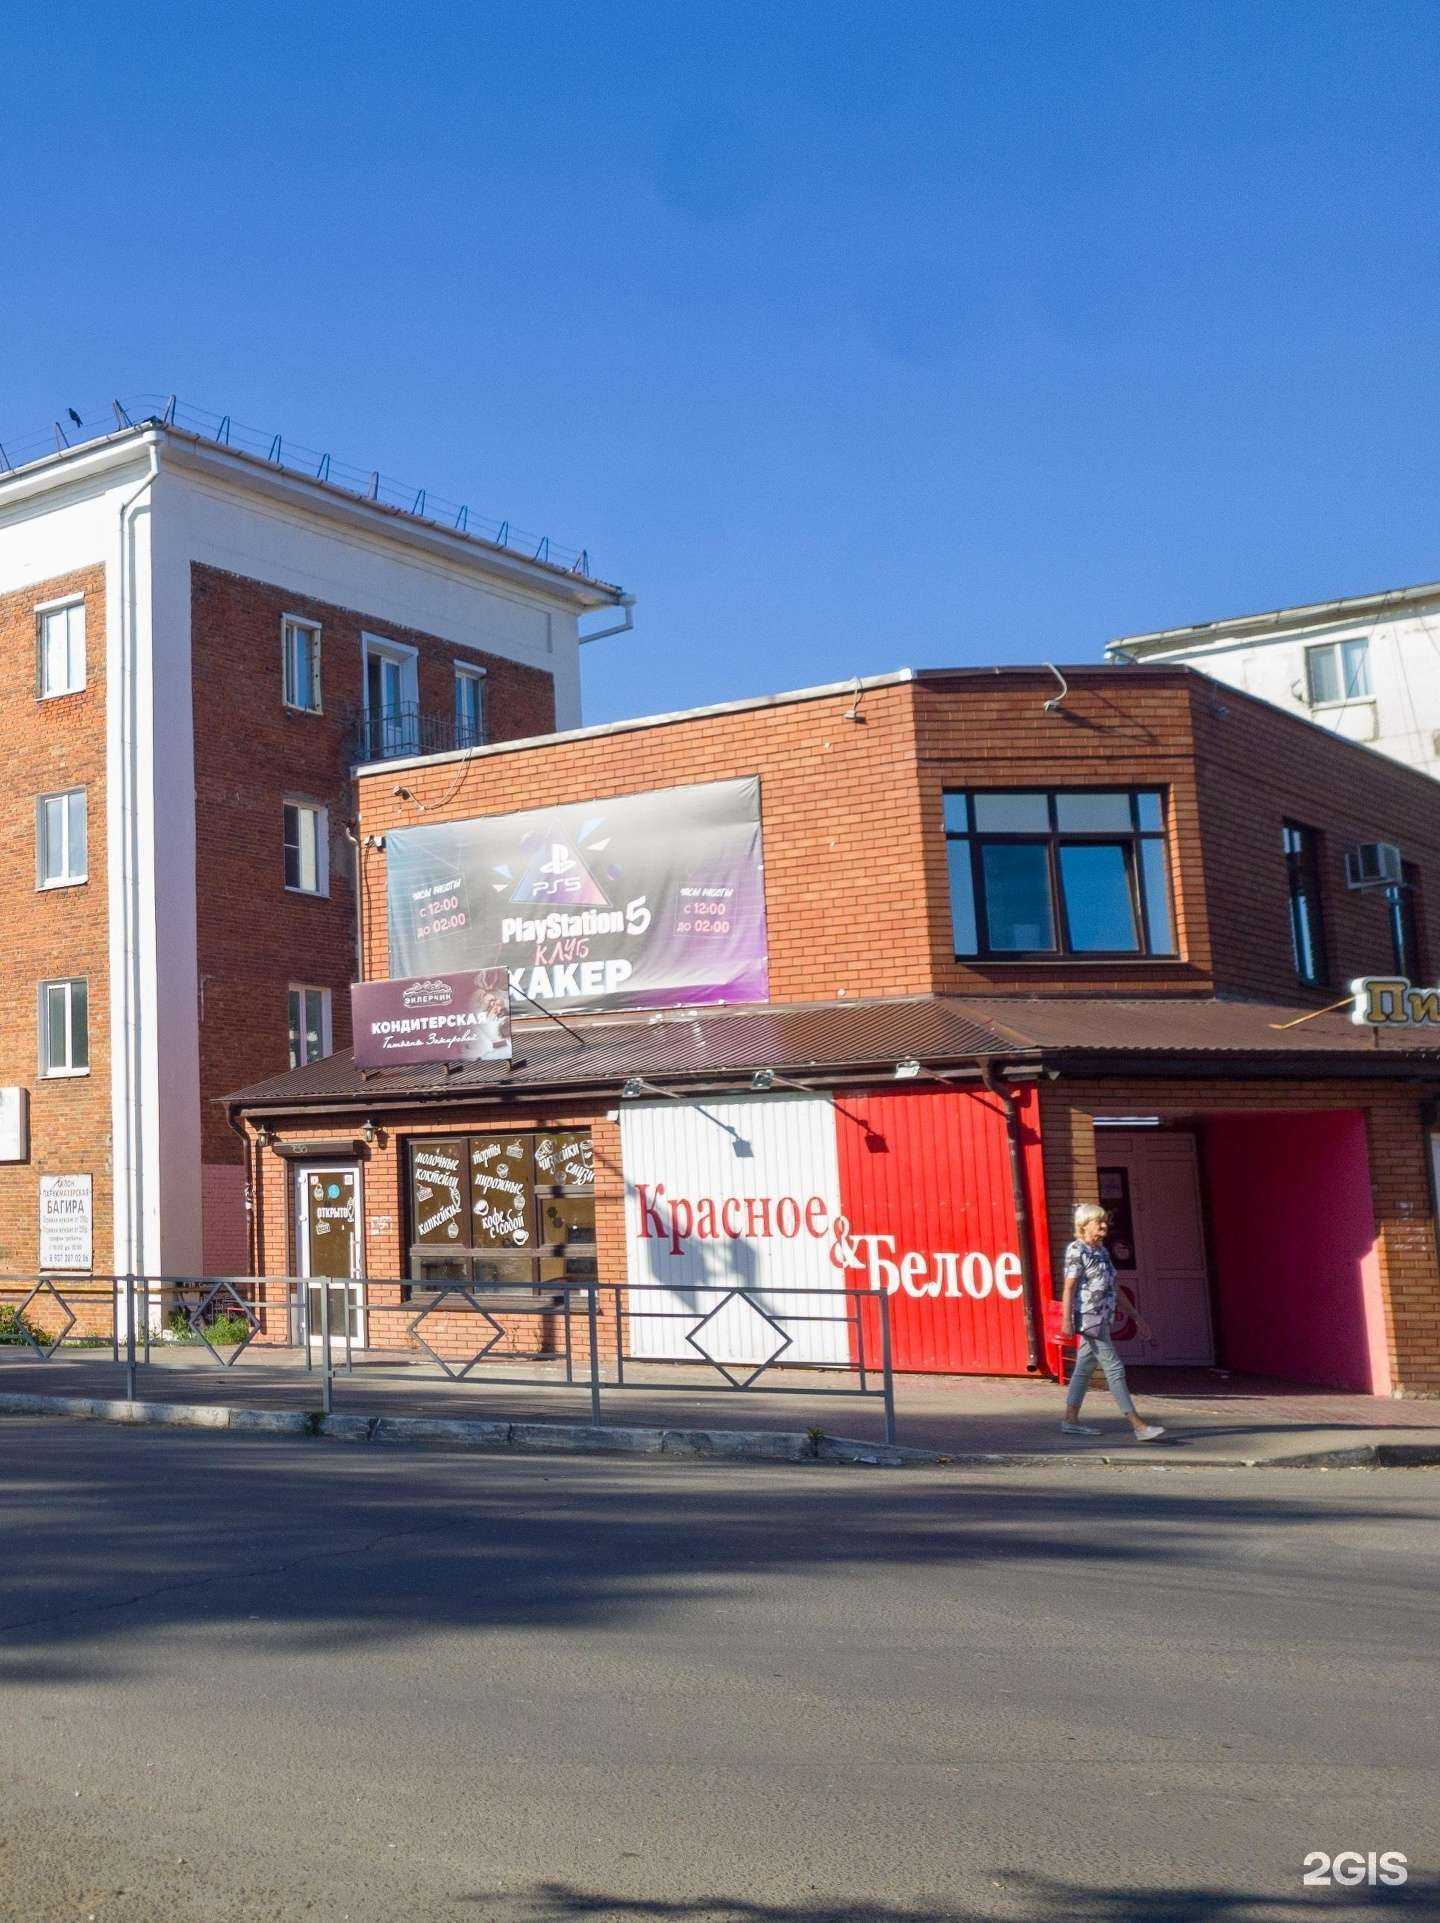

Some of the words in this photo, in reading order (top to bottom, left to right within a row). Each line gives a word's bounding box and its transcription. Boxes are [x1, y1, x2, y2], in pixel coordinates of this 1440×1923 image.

[532, 877, 583, 896] PS5
[428, 896, 458, 915] 12:00
[694, 902, 726, 915] 12:00
[433, 913, 465, 932] 02:00
[502, 909, 625, 943] PlayStation
[626, 896, 651, 935] 5
[695, 919, 730, 933] 02:00
[371, 1011, 487, 1035] КОНДИТЕРСКАЯ
[415, 1152, 460, 1171] молочные
[415, 1168, 460, 1188] коктейли
[474, 1173, 524, 1195] пирожные
[47, 1199, 84, 1214] БАГИРА
[317, 1207, 350, 1218] ОТКРЫТО
[634, 1184, 829, 1256] Красное
[829, 1216, 866, 1269] &
[863, 1235, 1023, 1300] Белое
